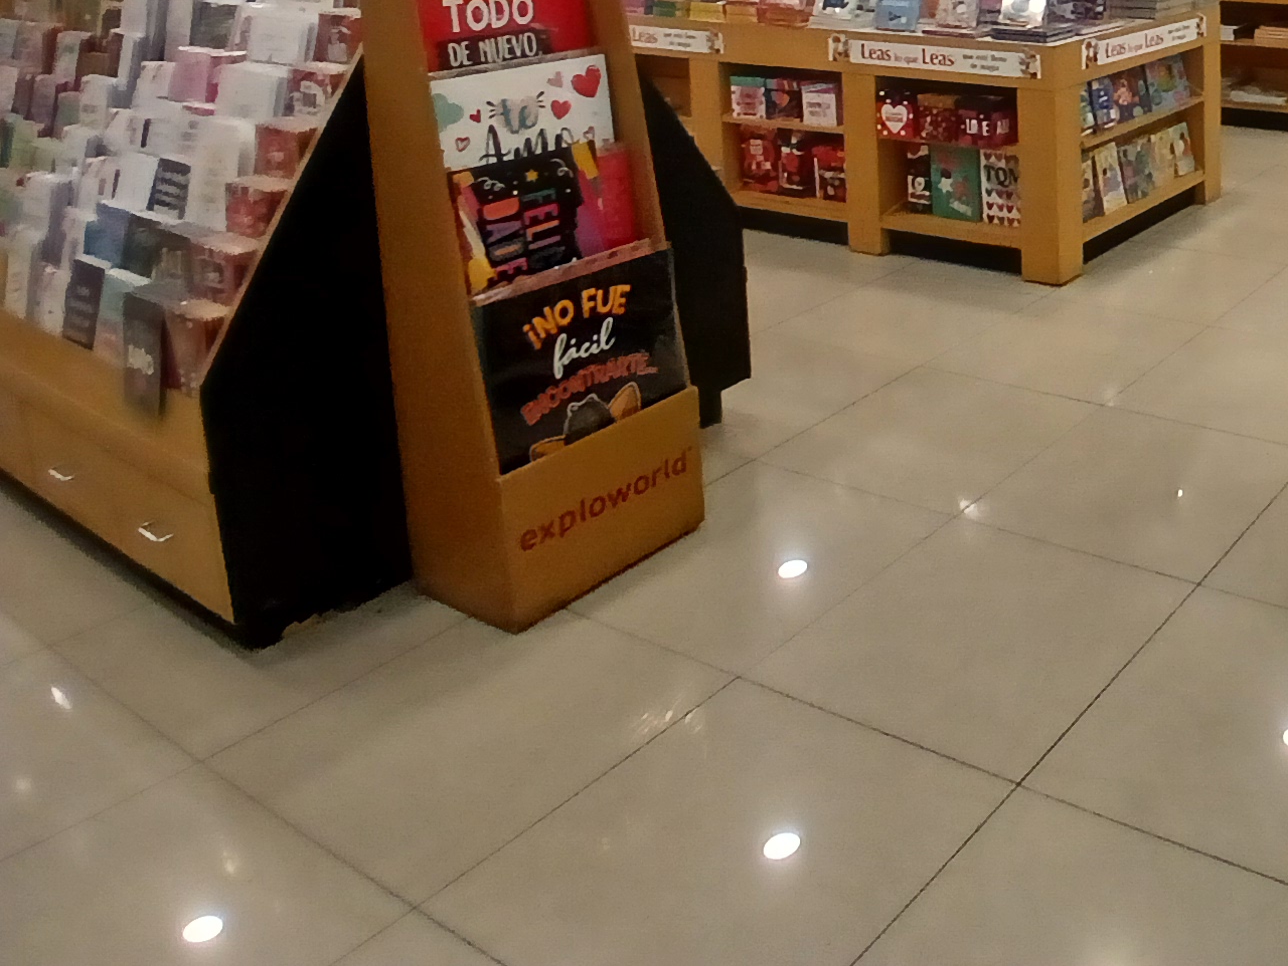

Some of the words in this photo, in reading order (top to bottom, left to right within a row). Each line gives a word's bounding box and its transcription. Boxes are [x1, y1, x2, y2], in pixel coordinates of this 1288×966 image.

[448, 40, 473, 67] DE
[860, 43, 891, 62] Leas
[922, 47, 955, 67] Leas
[582, 284, 631, 319] FUE
[552, 316, 616, 380] fácil
[519, 450, 690, 552] exploworld
